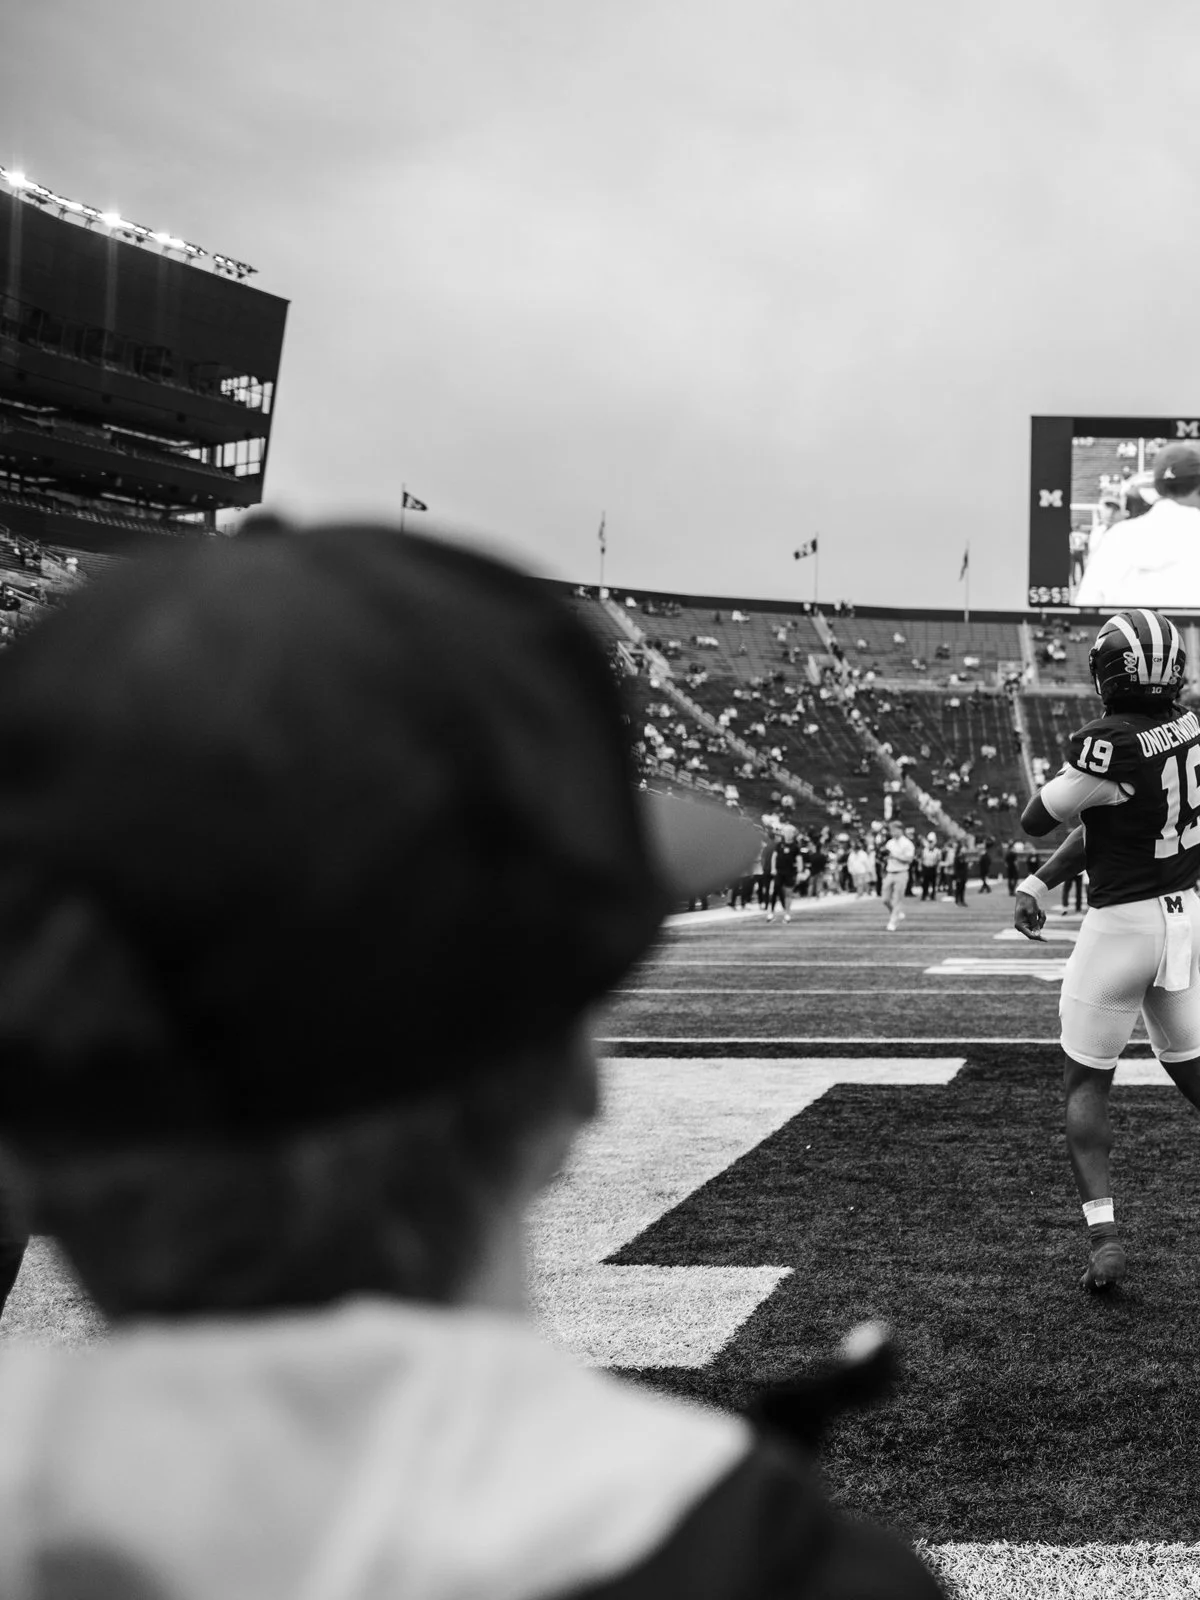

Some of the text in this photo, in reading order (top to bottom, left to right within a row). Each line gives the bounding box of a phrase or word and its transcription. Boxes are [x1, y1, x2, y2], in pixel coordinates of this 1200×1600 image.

[1039, 489, 1063, 507] M
[1077, 736, 1113, 773] 19
[1164, 895, 1184, 913] M
